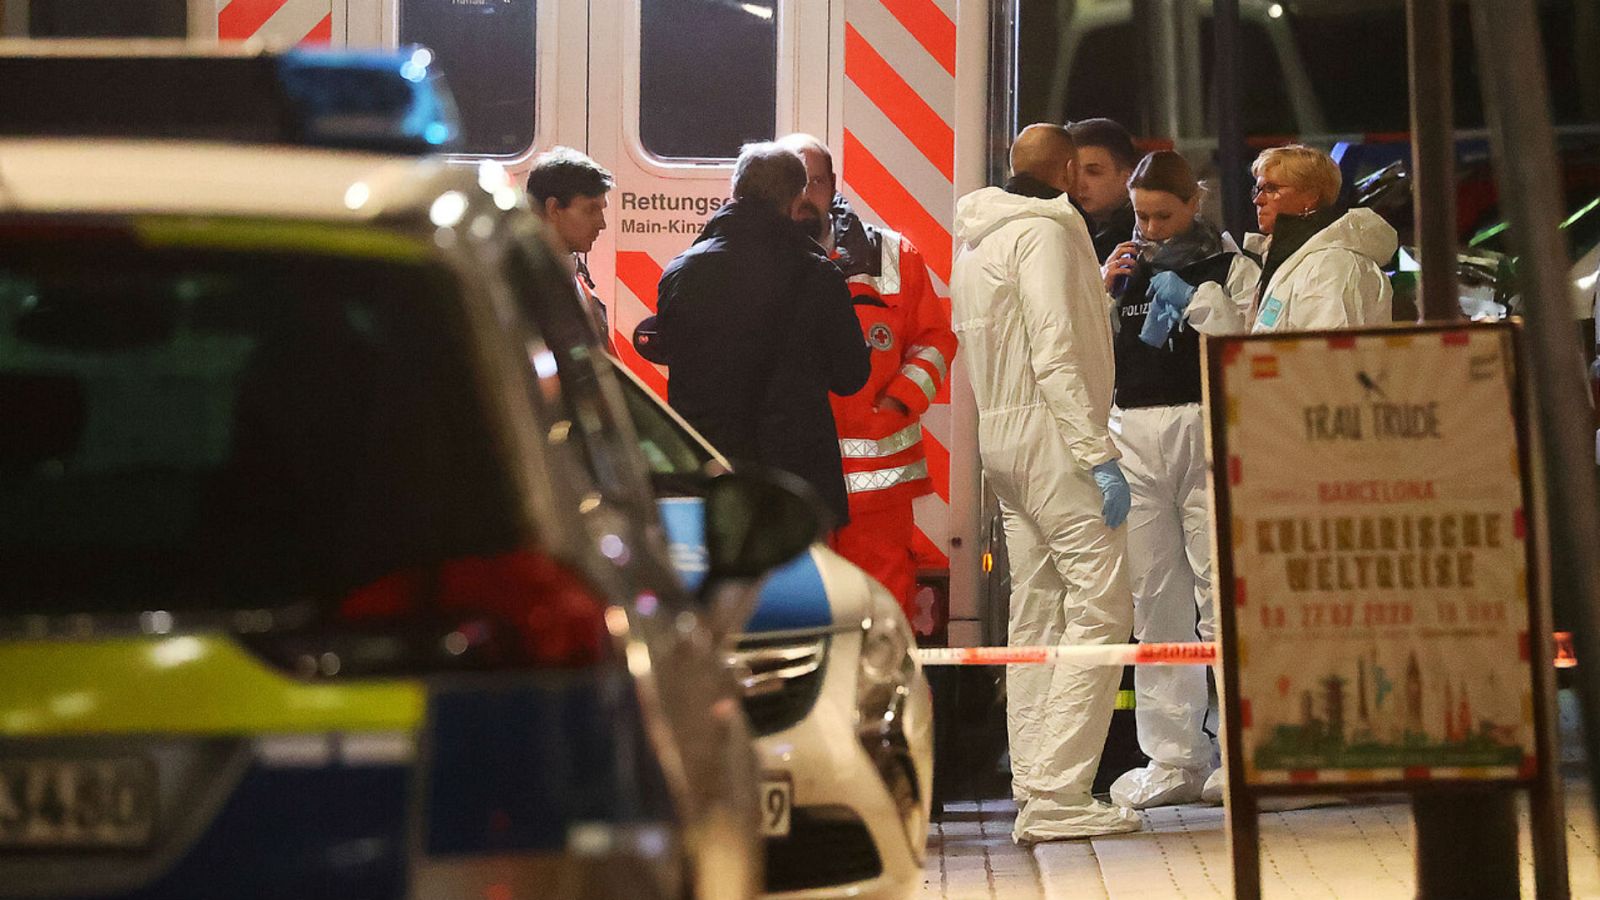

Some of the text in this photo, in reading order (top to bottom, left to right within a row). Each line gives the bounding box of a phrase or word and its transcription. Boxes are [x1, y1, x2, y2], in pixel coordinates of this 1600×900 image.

[621, 192, 730, 215] Rettungs
[621, 219, 709, 234] Main-Kinz
[1318, 480, 1435, 502] BARCELONA
[1256, 514, 1500, 552] KULINARISCHE
[1286, 552, 1474, 590] WELTREISE
